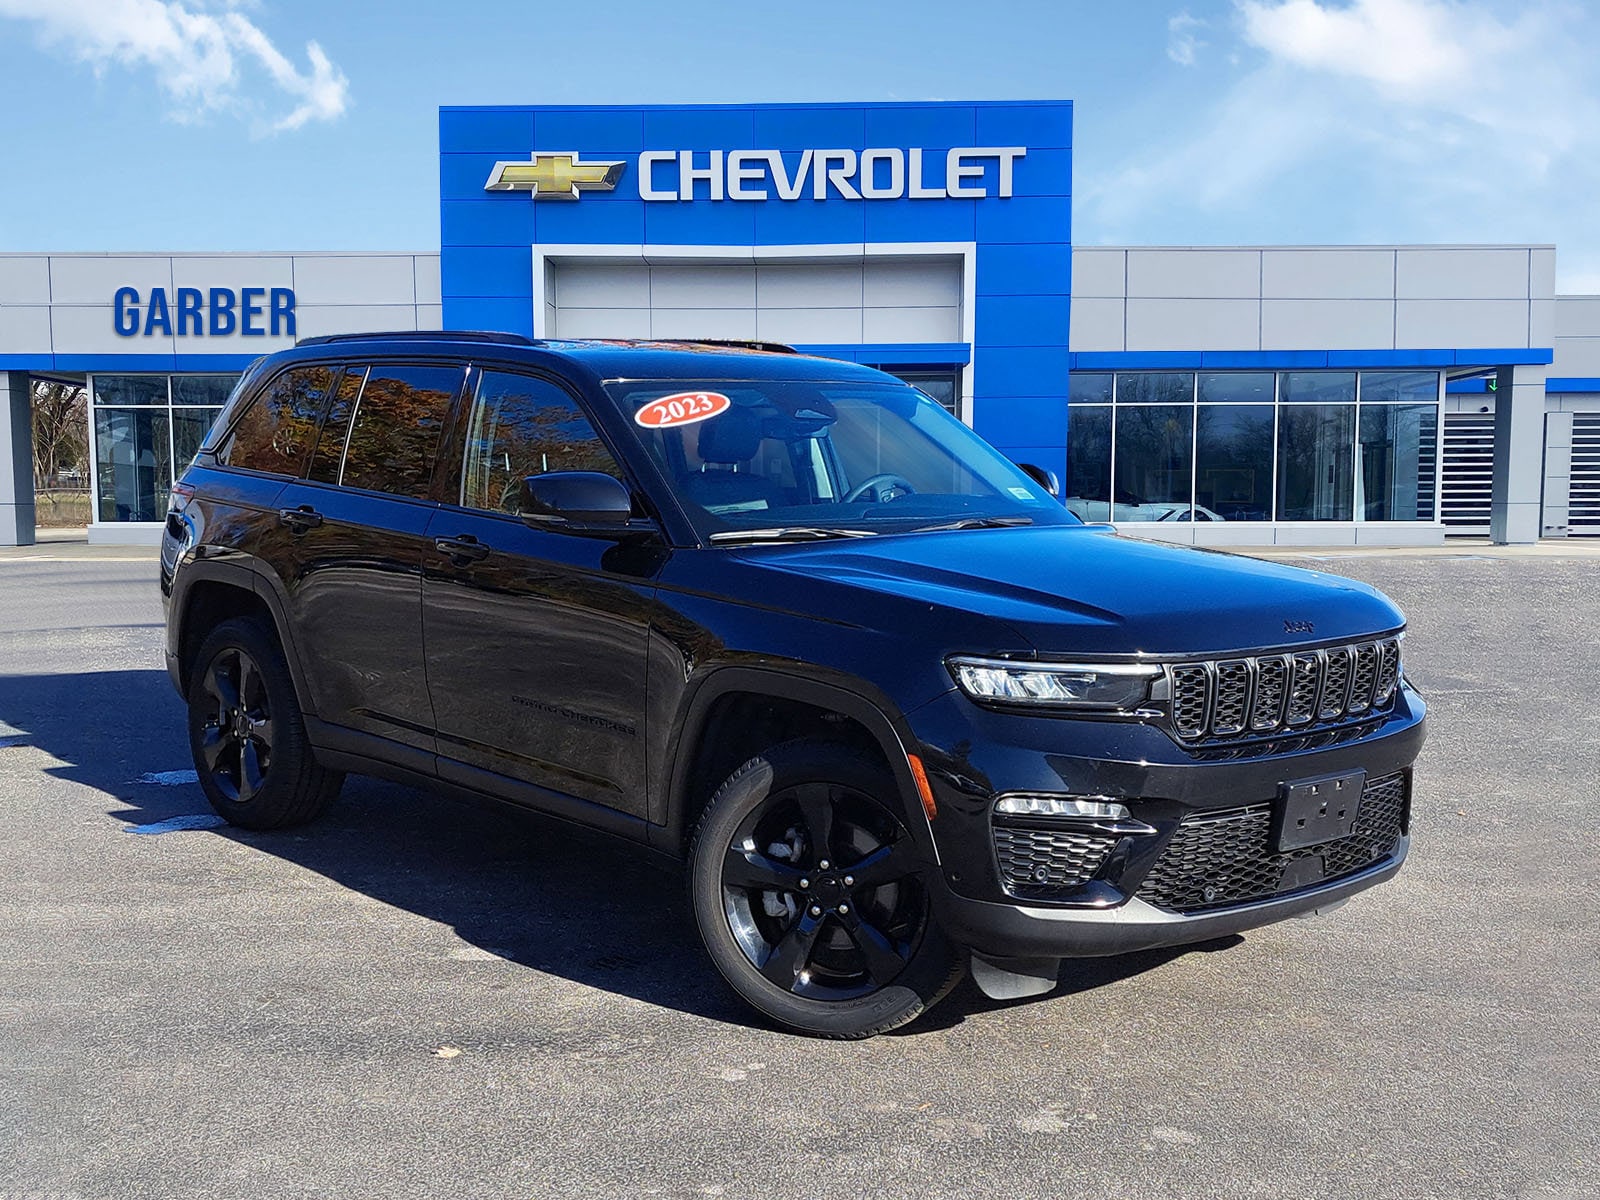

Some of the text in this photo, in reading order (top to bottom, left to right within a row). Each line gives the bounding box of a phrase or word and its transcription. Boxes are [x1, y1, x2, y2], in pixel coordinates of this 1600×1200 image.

[638, 146, 1027, 201] CHEVROLET
[114, 286, 296, 337] GARBER
[653, 395, 713, 424] 2023
